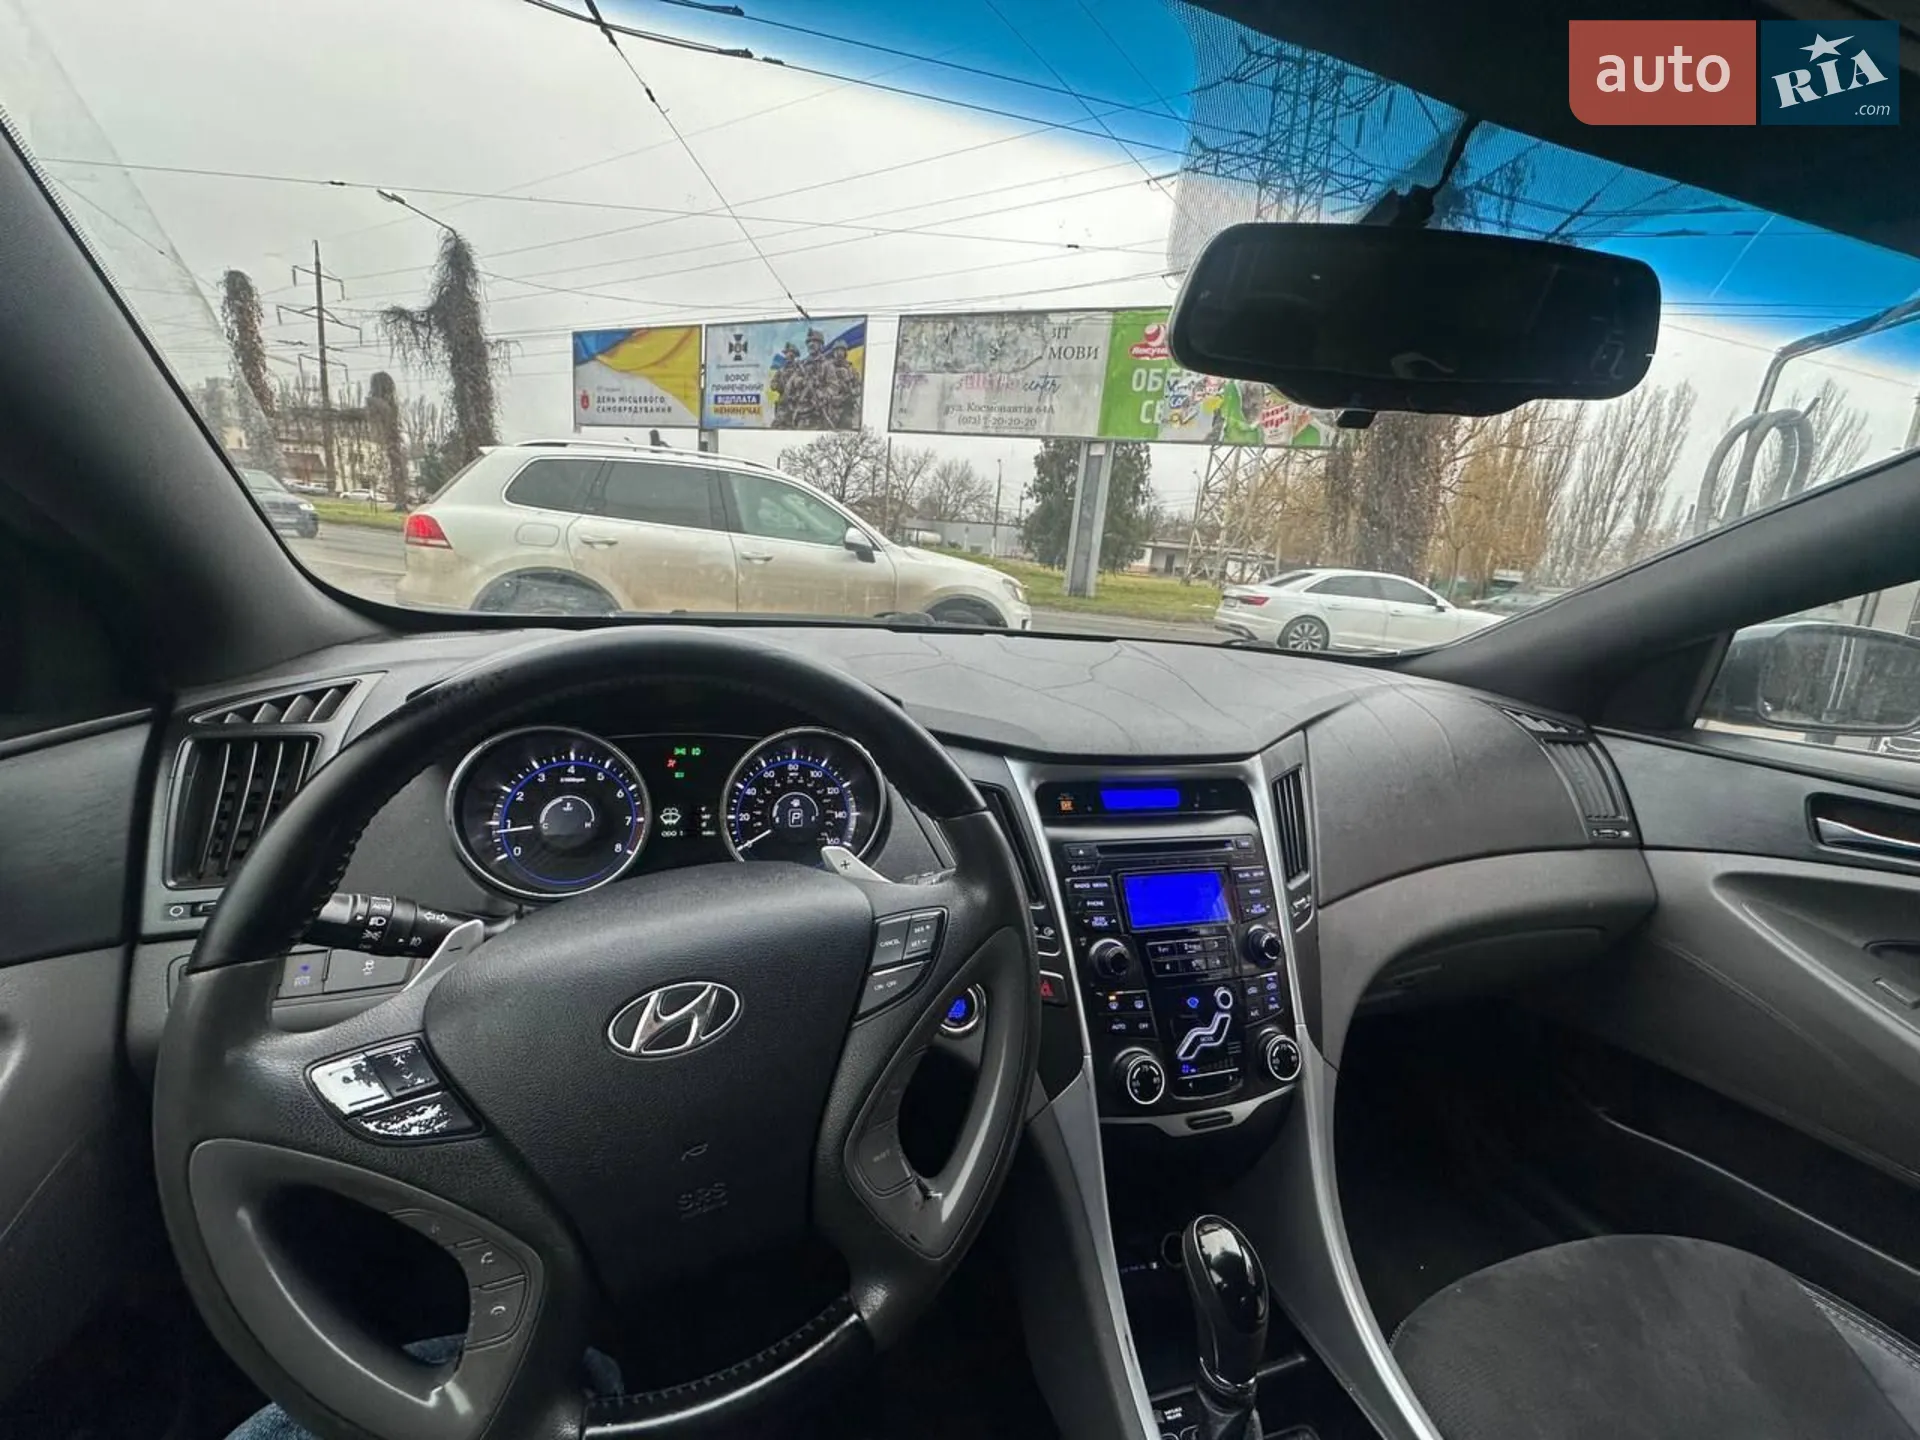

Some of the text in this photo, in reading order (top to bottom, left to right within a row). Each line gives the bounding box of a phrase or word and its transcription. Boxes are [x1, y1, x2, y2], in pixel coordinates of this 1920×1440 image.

[1049, 345, 1100, 360] МОВИ
[596, 395, 616, 404] ДЕНЬ
[567, 765, 576, 774] 4
[763, 770, 775, 778] 60
[810, 770, 822, 778] 100
[537, 773, 546, 782] 3
[597, 772, 605, 781] 5
[616, 789, 624, 798] 6
[745, 787, 757, 795] 40
[827, 787, 840, 795] 120
[516, 791, 524, 801] 2
[625, 816, 632, 826] 7
[739, 813, 750, 821] 20
[791, 814, 801, 824] P
[506, 819, 512, 829] 1
[513, 846, 522, 857] 0
[614, 843, 622, 853] 8
